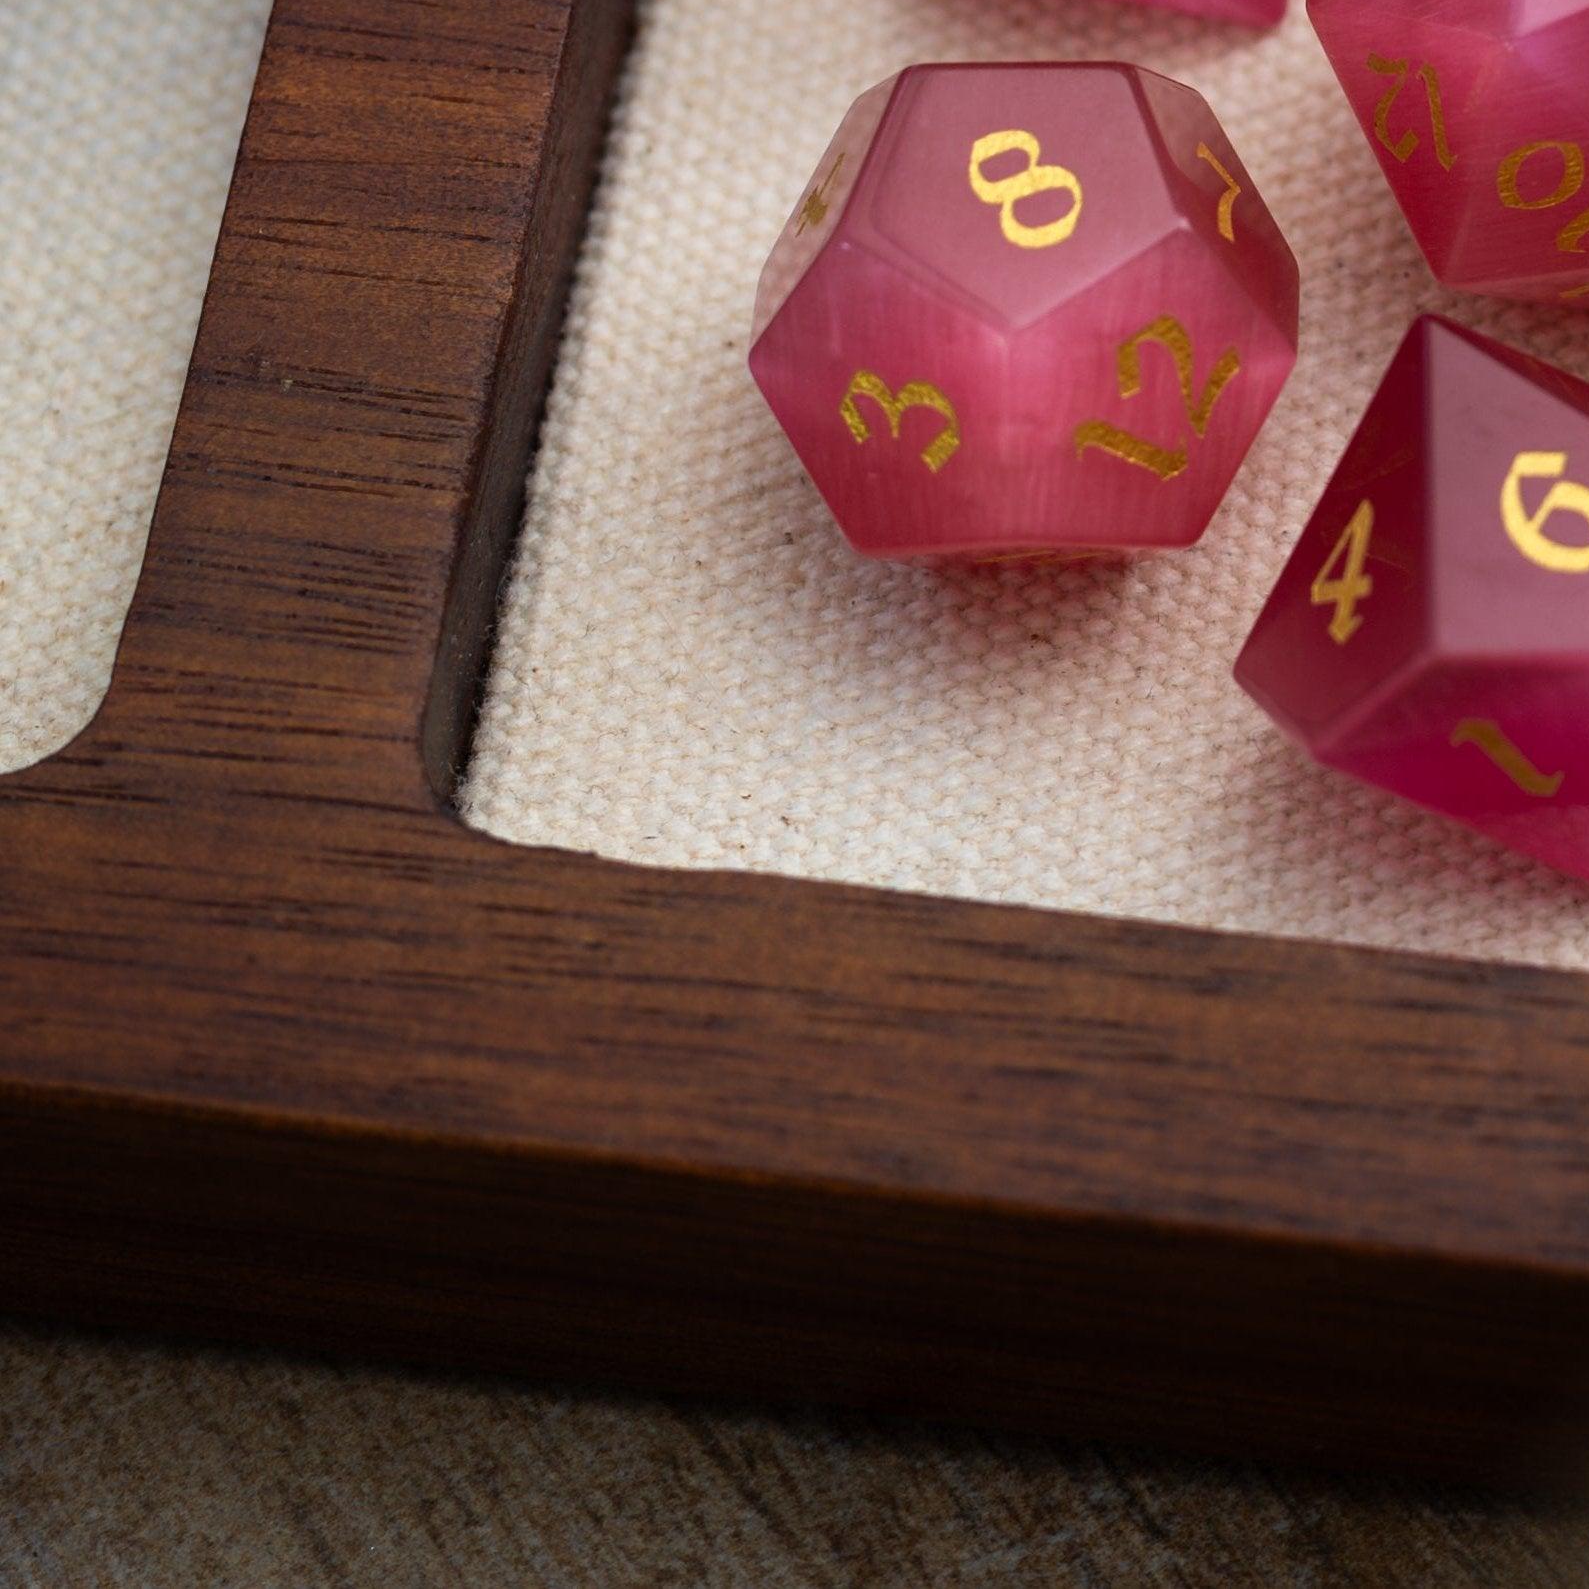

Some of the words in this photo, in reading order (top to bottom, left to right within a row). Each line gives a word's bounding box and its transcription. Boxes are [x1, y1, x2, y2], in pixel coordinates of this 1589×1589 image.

[1365, 52, 1456, 173] 12
[969, 129, 1082, 249] 8
[839, 369, 961, 474] 3
[1074, 314, 1242, 482] 12
[1310, 498, 1375, 645] 4
[1449, 715, 1565, 798] 1
